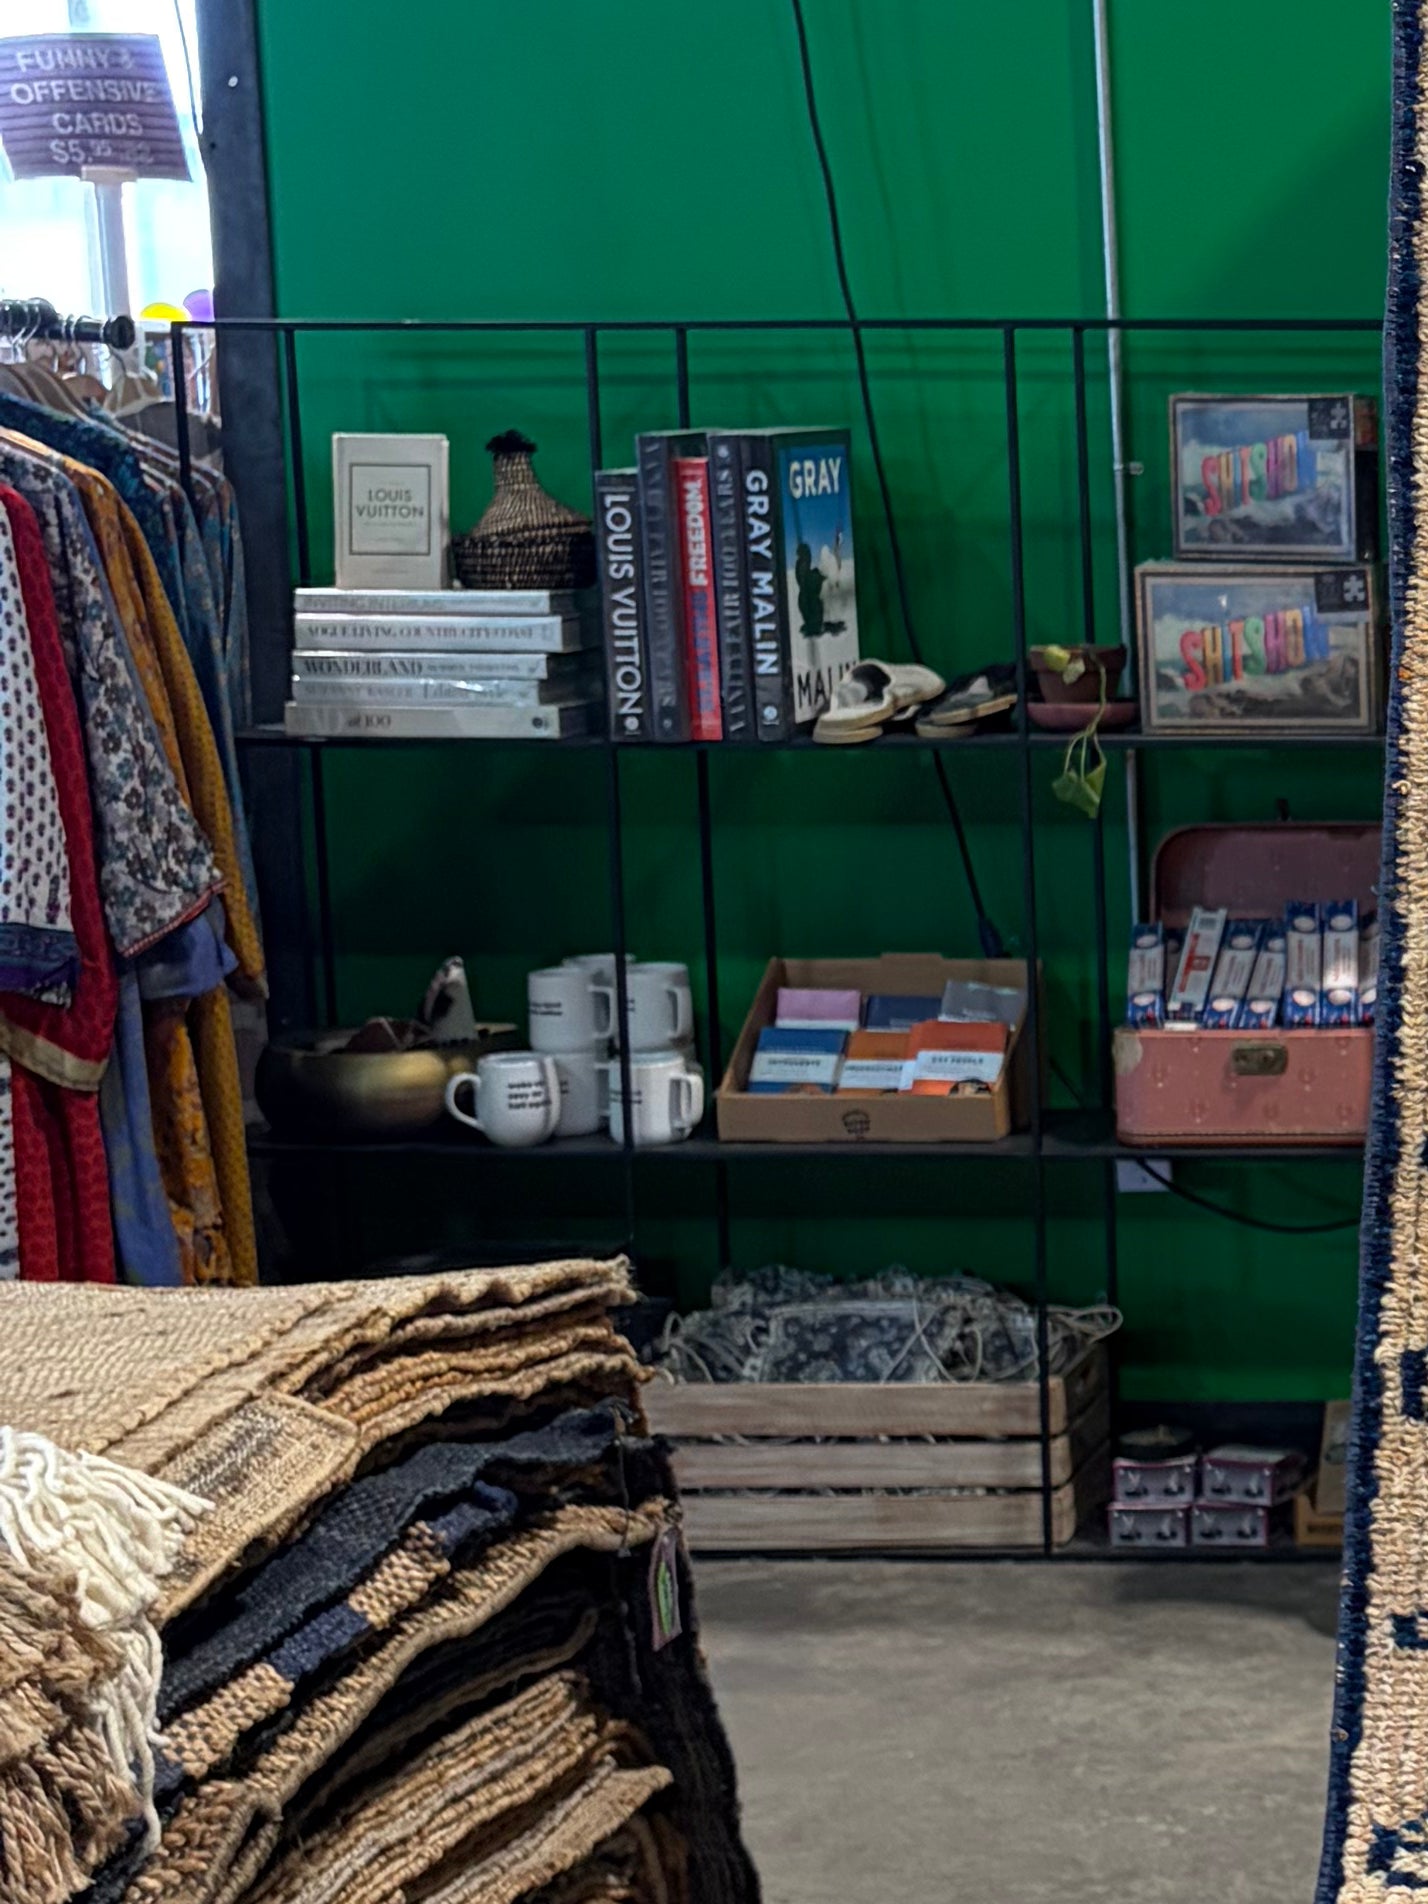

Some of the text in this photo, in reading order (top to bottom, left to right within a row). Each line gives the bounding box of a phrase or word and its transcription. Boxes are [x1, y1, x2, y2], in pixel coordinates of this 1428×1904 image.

[16, 48, 111, 73] FUNNY
[10, 78, 160, 105] OFFENSIVE
[52, 112, 143, 136] CARDS
[789, 457, 841, 499] GRAY
[368, 487, 412, 502] LOUIS
[356, 504, 424, 518] VUITTON
[684, 480, 708, 587] FREEDOM
[746, 470, 779, 675] GRAY MALIN
[603, 494, 644, 715] LOUIS VUITTON
[303, 659, 423, 676] WONDERLAND
[797, 659, 858, 709] MAL
